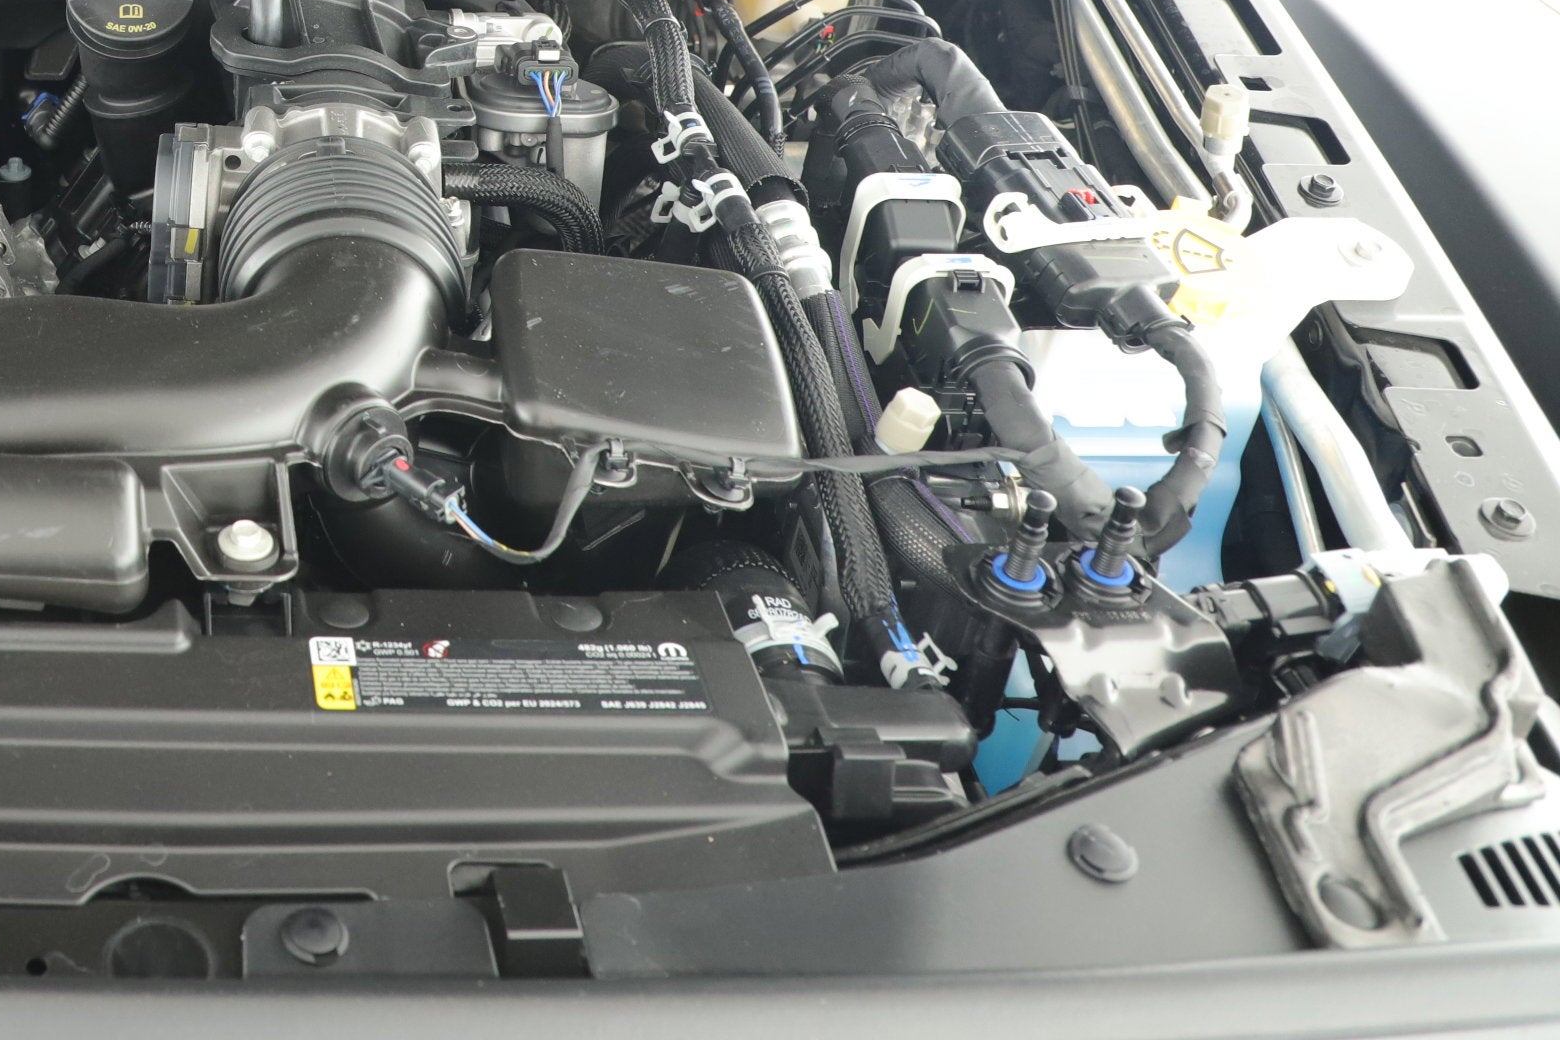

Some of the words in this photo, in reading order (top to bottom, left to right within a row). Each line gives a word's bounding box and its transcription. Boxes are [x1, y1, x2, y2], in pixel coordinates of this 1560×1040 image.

[105, 22, 126, 33] SAE
[128, 21, 157, 33] 0W-20
[764, 596, 792, 609] RAD
[372, 641, 412, 649] R-1234yf
[373, 648, 395, 656] GWP
[383, 697, 405, 706] PAG
[446, 698, 471, 707] GWP
[472, 699, 481, 707] &
[482, 699, 503, 707] CO2
[505, 700, 521, 708] per
[522, 699, 537, 707] EU
[601, 700, 623, 709] SAE
